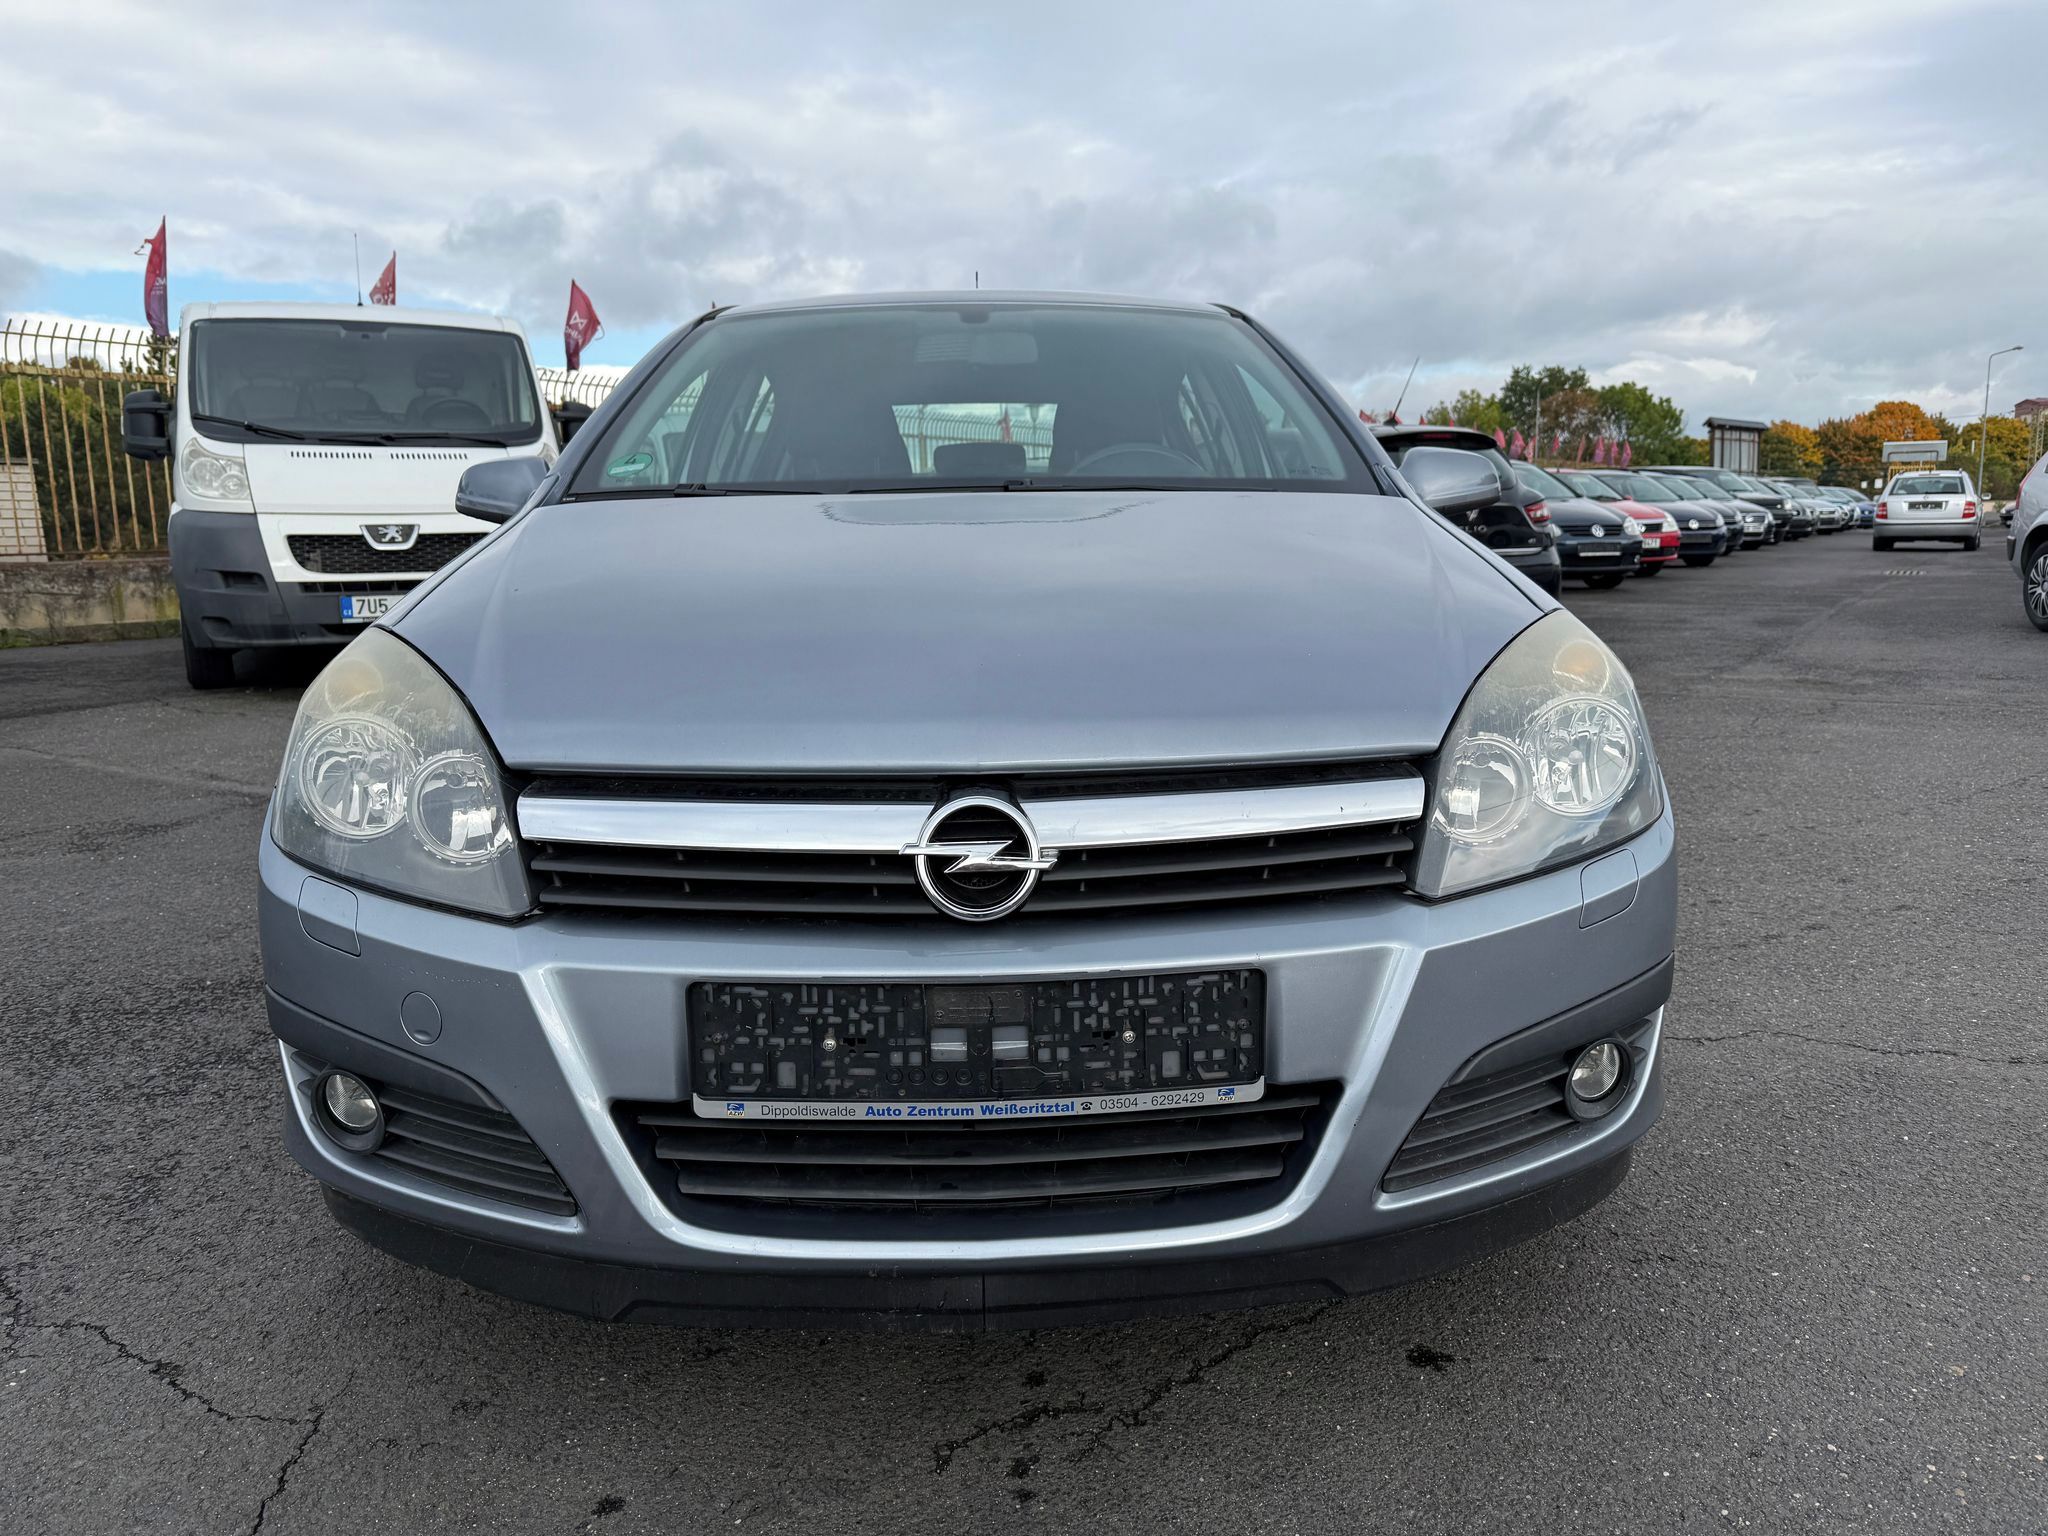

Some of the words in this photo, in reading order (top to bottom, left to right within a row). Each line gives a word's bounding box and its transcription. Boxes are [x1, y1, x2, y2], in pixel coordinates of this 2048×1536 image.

[624, 454, 637, 464] 4
[761, 1105, 856, 1118] Dippoldiswalde
[865, 1105, 902, 1117] Auto
[907, 1105, 975, 1117] Zentrum
[980, 1101, 1075, 1116] Weißeritztal
[1100, 1097, 1138, 1110] 03504
[1151, 1092, 1205, 1107] 6292429
